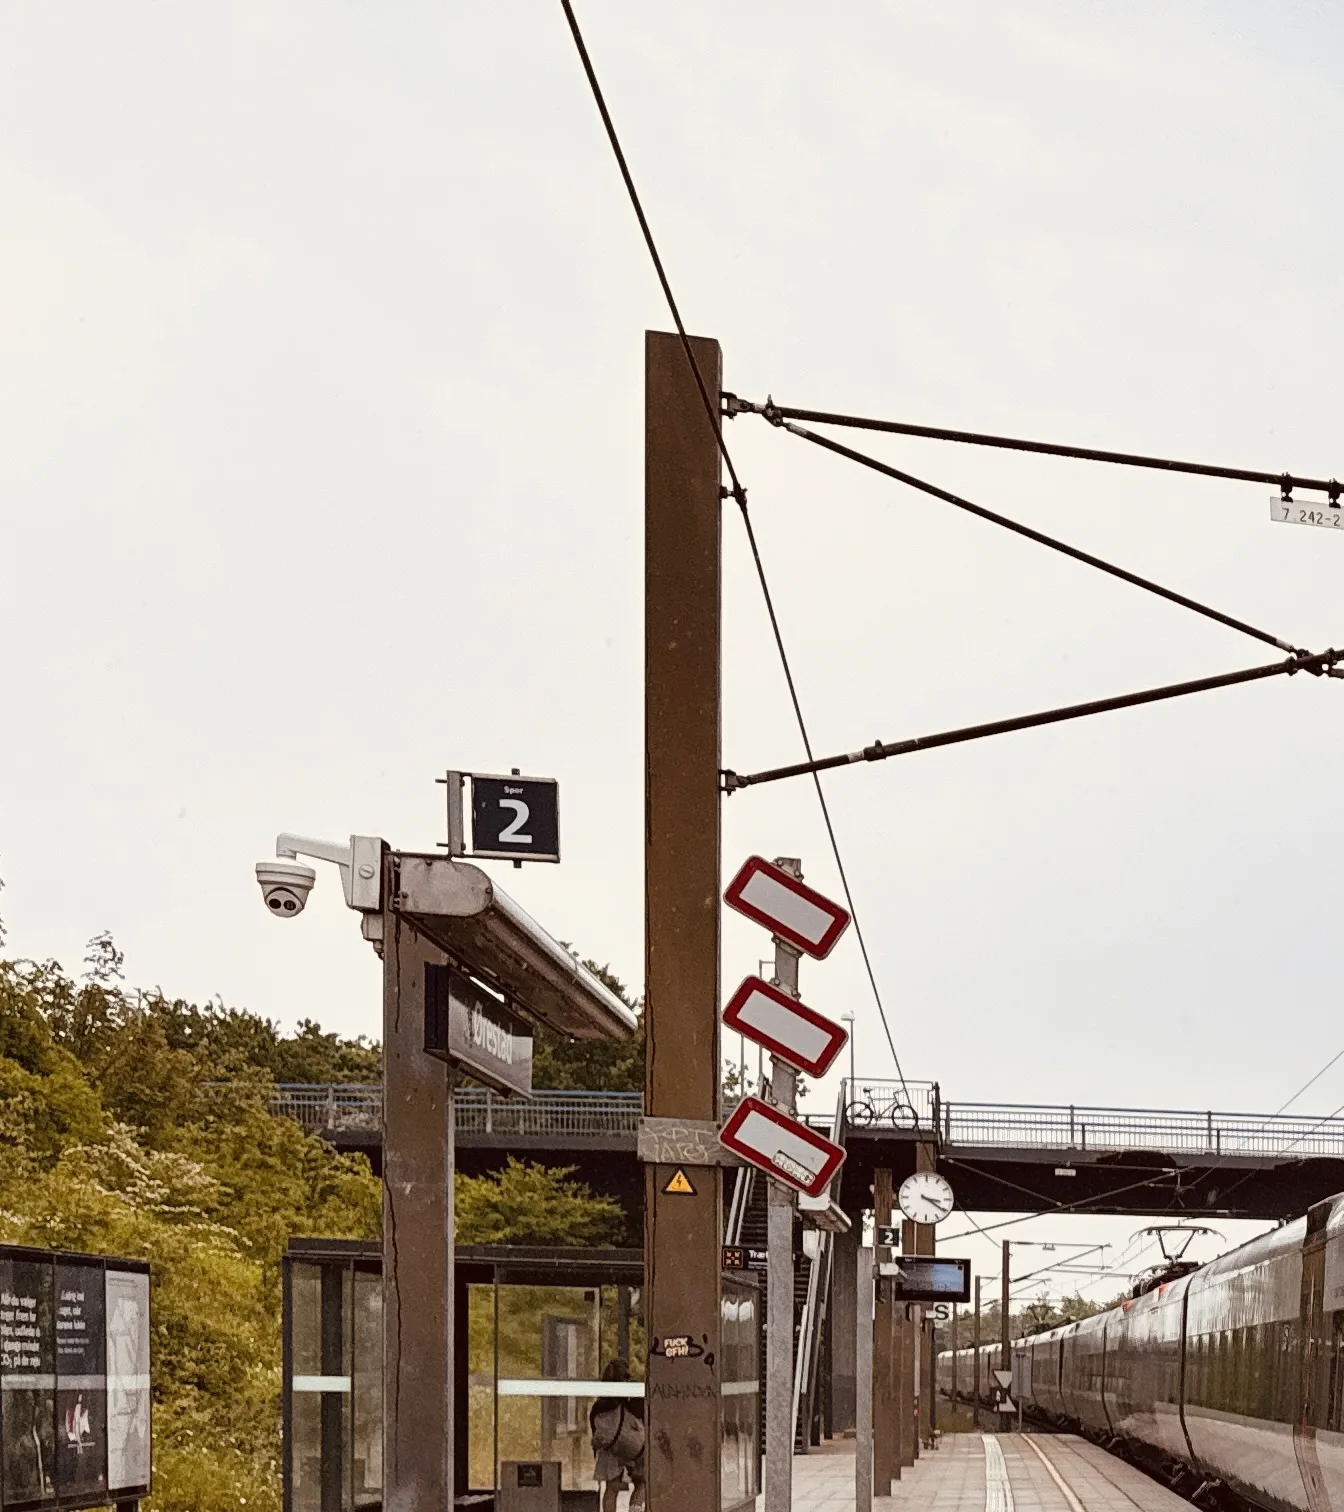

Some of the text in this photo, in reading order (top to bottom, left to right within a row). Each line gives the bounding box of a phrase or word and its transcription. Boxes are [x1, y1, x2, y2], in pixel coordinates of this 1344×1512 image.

[503, 785, 524, 795] Spor
[498, 798, 533, 844] 2
[884, 1232, 894, 1244] 2
[935, 1304, 949, 1320] S
[664, 1337, 688, 1348] FUCK
